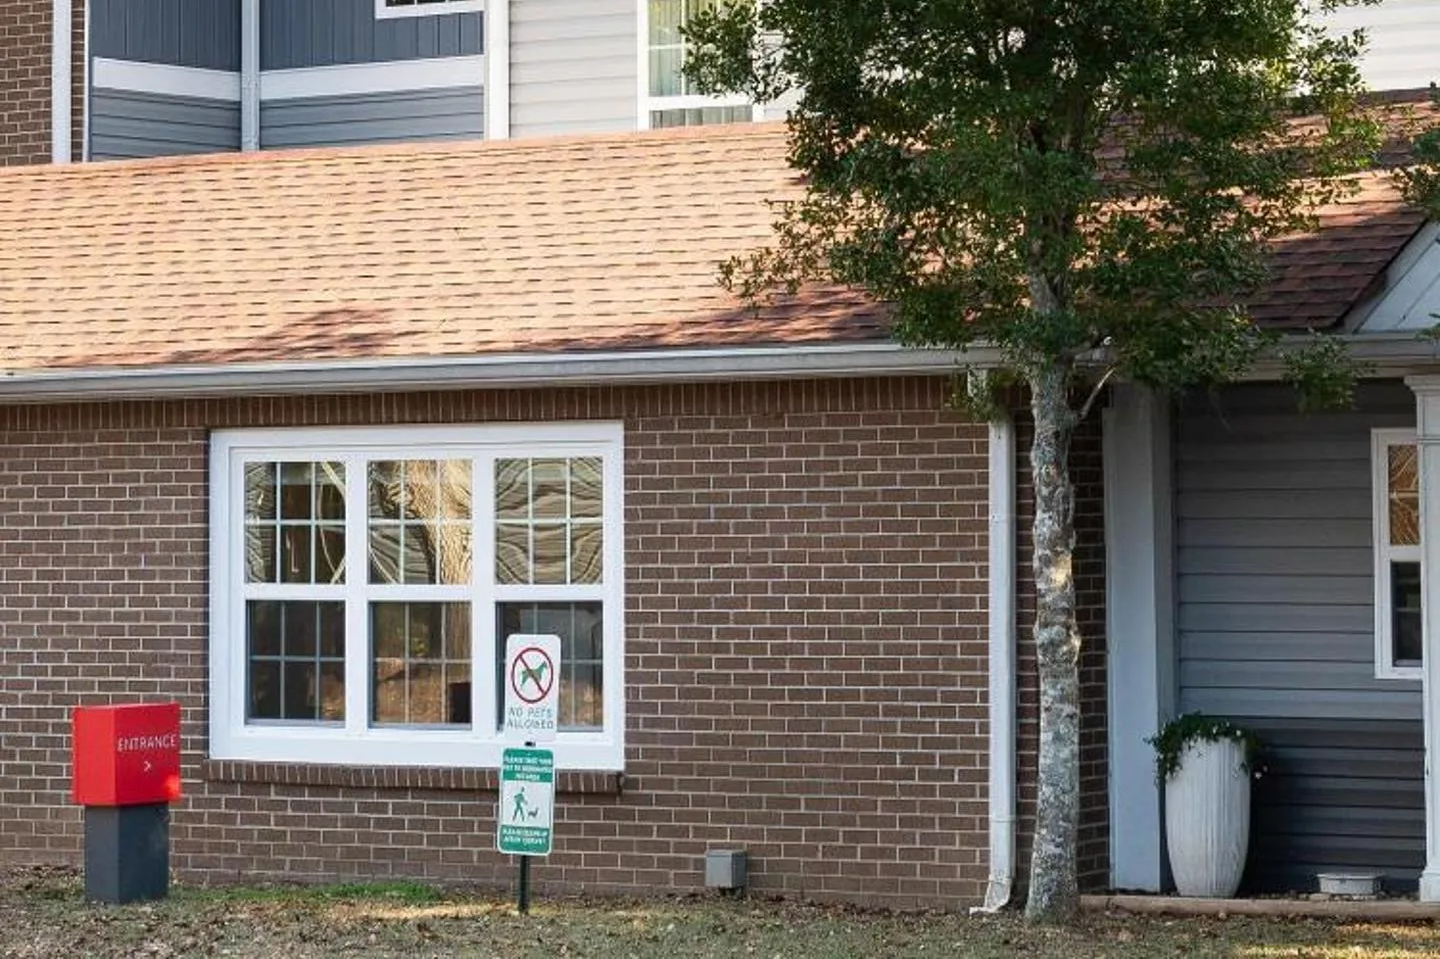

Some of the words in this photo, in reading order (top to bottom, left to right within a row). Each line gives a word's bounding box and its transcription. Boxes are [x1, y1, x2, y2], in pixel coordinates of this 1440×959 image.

[508, 707, 523, 717] NO
[528, 707, 553, 718] PETS
[507, 718, 553, 729] ALLOWED
[117, 733, 177, 752] ENTRANCE
